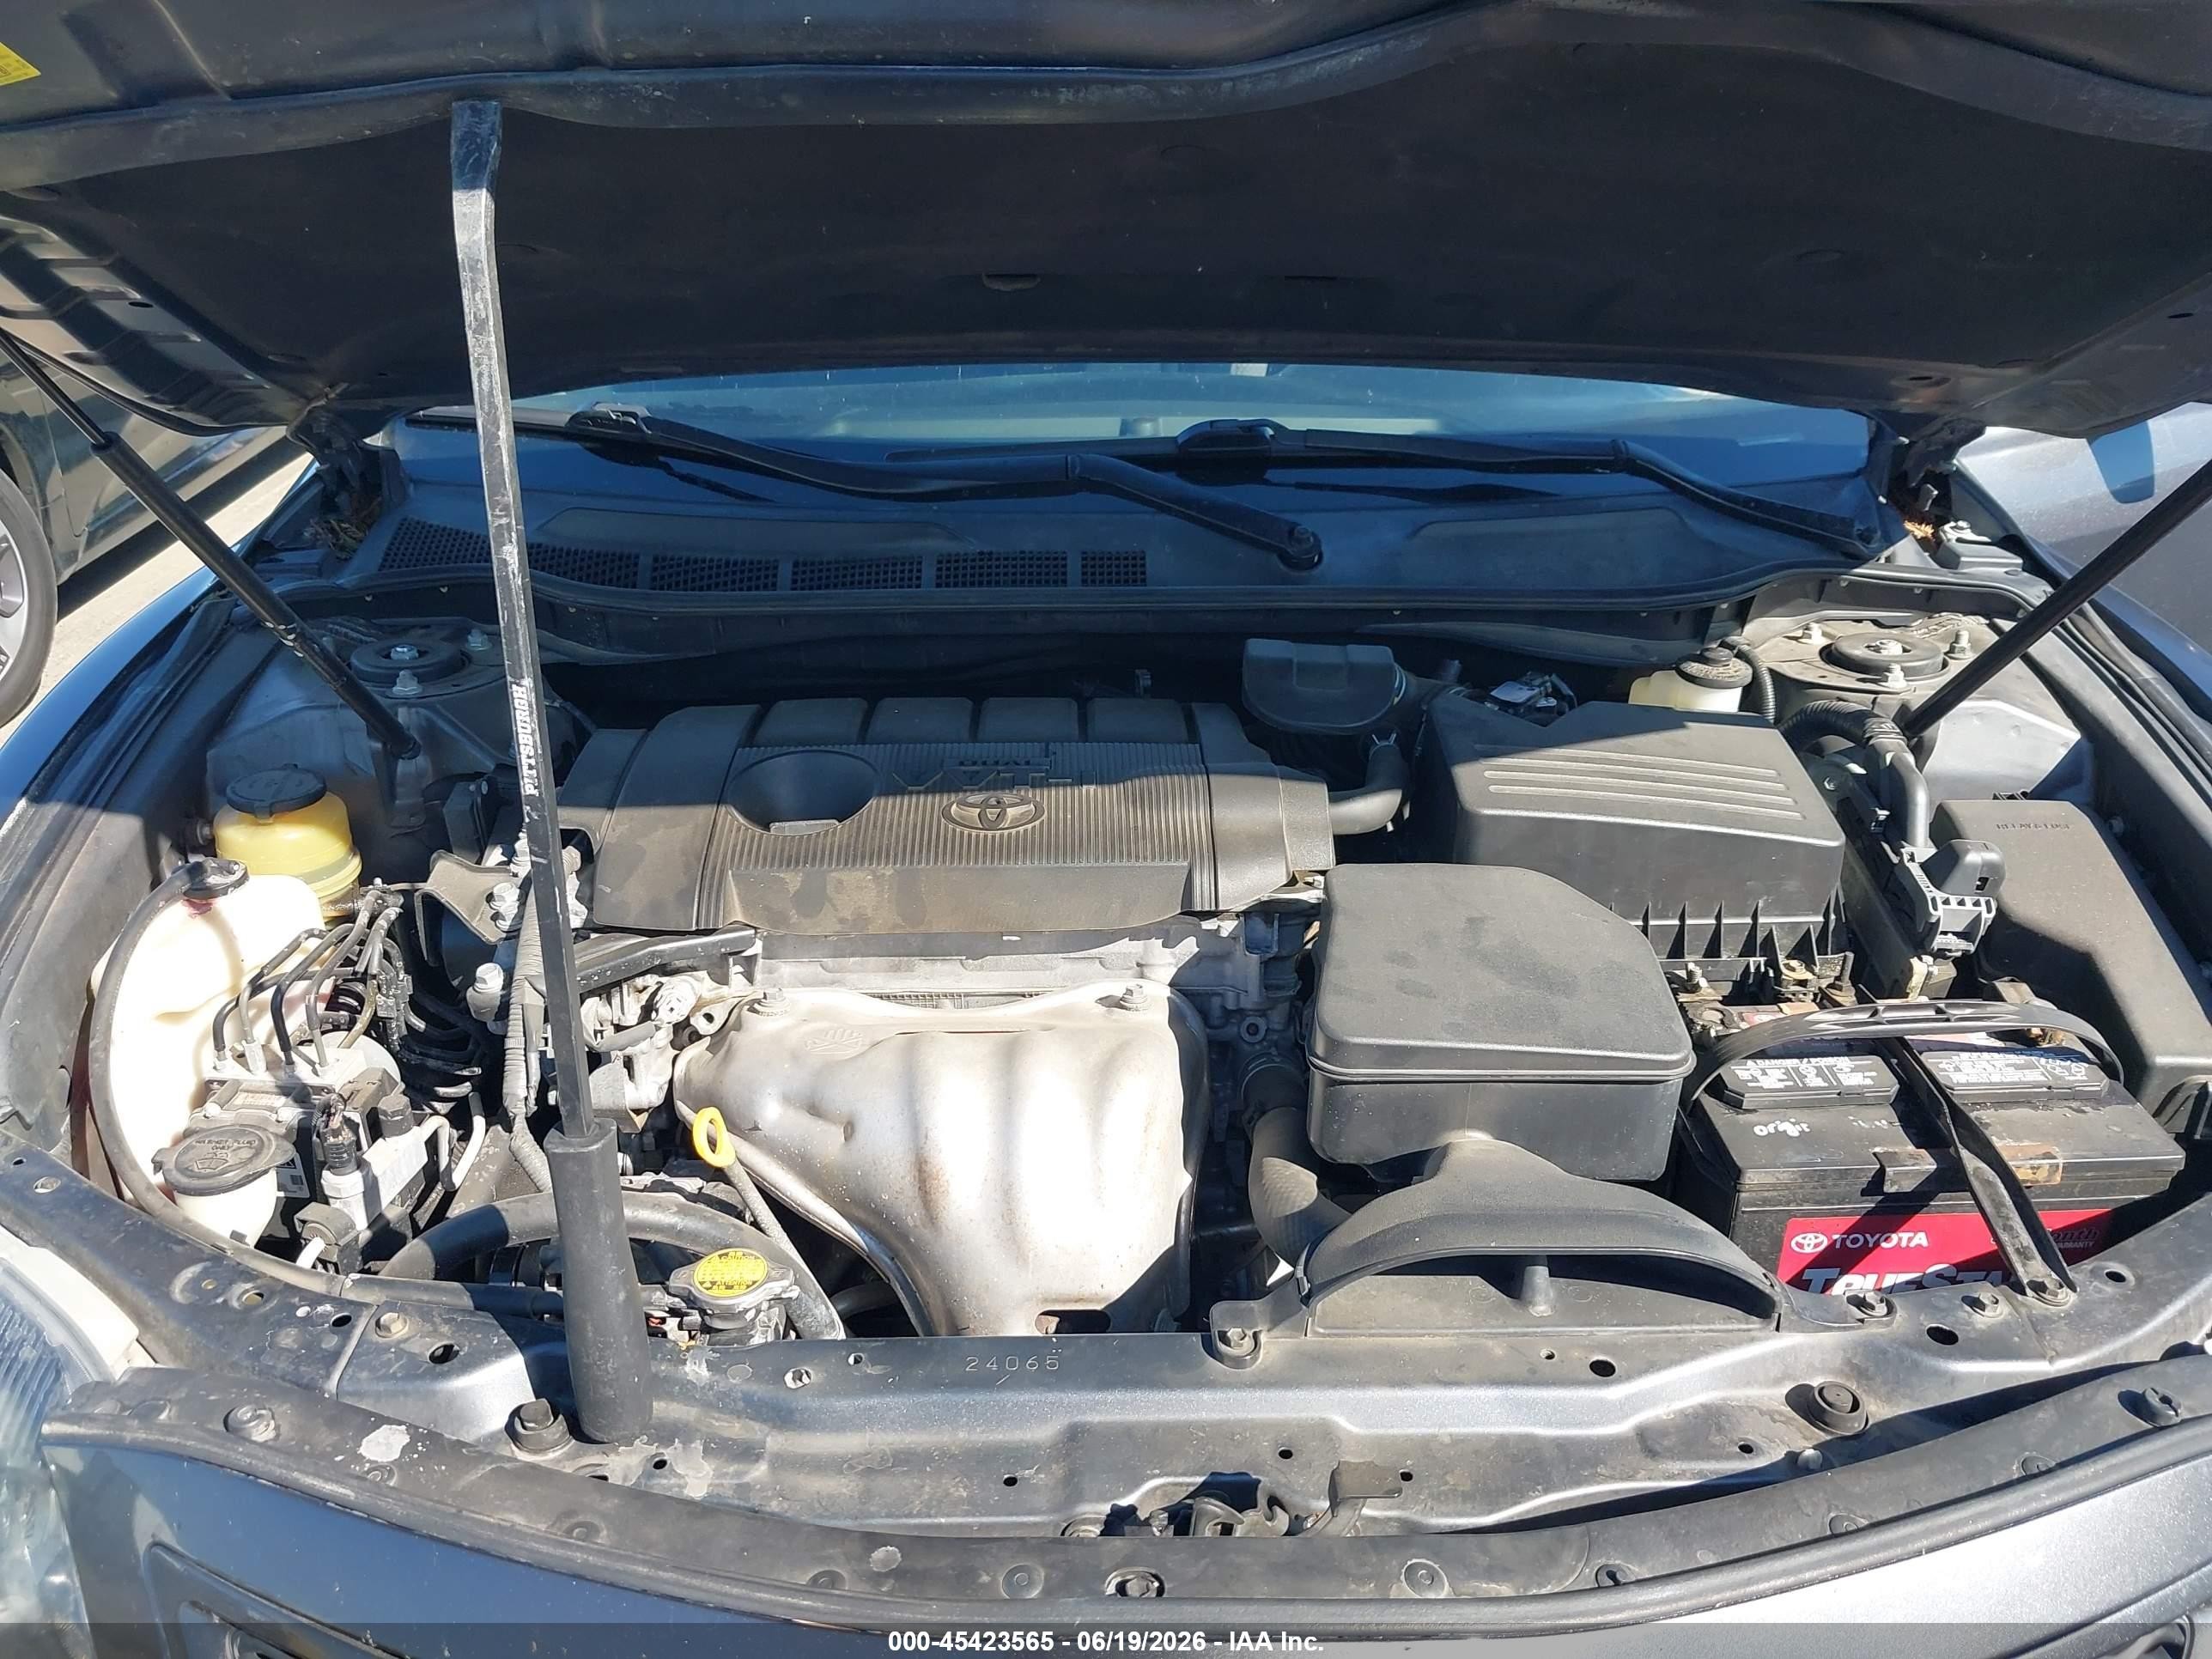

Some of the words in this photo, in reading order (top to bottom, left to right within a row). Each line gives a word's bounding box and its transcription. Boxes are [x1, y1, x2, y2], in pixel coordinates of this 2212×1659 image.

[511, 684, 540, 797] PITTSBURGH
[1832, 1231, 1929, 1249] TOYOTA
[965, 1356, 1060, 1371] 24065
